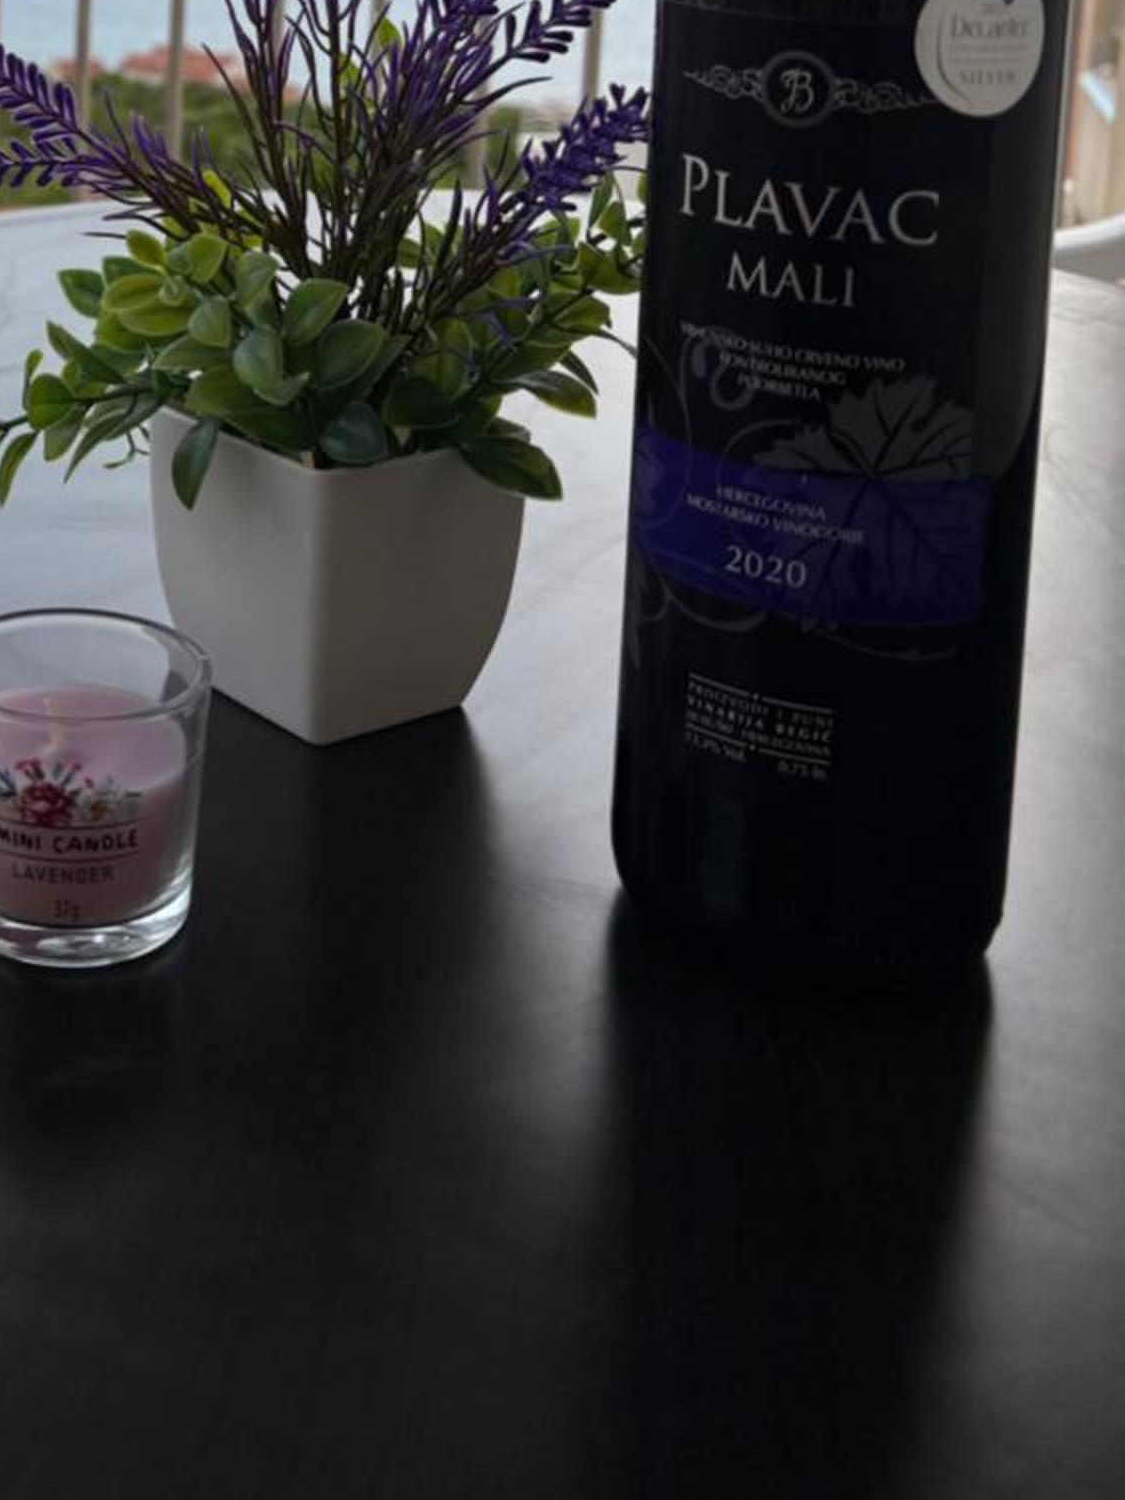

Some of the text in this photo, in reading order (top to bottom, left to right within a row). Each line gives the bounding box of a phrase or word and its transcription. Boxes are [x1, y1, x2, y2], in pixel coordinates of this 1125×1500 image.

[680, 152, 941, 247] PLAVAC
[725, 250, 858, 309] MALI
[861, 355, 907, 373] VINO
[724, 543, 808, 589] 2020
[51, 828, 139, 855] CANDLE
[10, 862, 115, 885] LAVENDER
